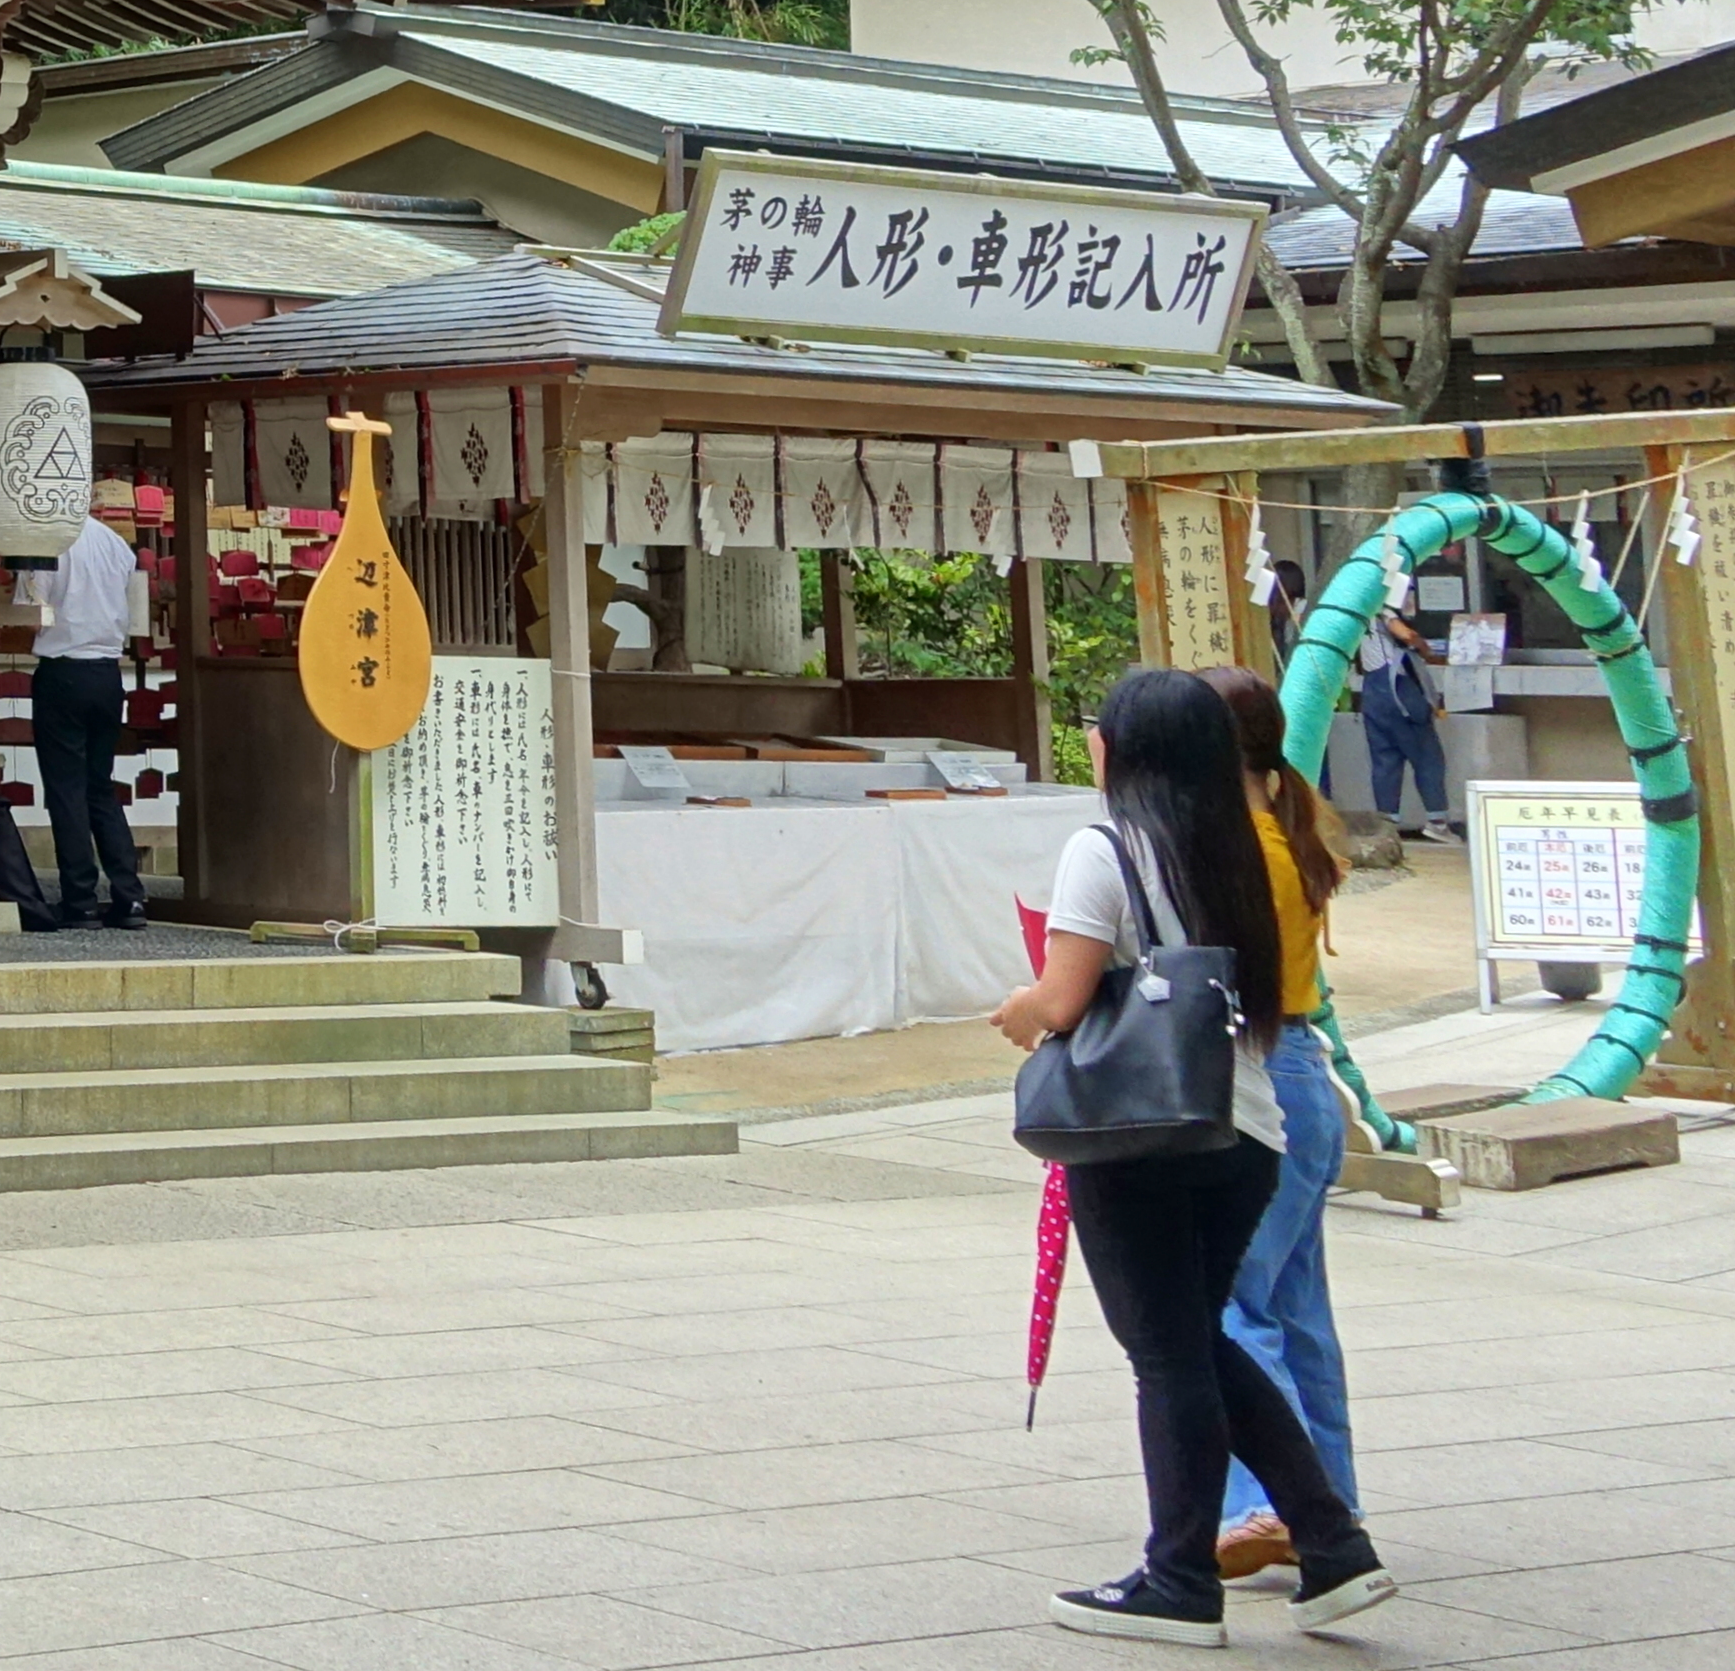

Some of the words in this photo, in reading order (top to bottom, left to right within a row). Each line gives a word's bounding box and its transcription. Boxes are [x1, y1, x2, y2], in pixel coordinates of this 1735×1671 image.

[720, 188, 826, 238] 茅の輪
[806, 205, 1227, 326] 人形・車形記入所
[726, 244, 795, 289] 神事
[354, 559, 380, 689] 辺津宮
[1199, 516, 1228, 669] 人形に罪穢
[484, 680, 498, 785] 身代りとします
[1517, 806, 1624, 821] 厄年早見表
